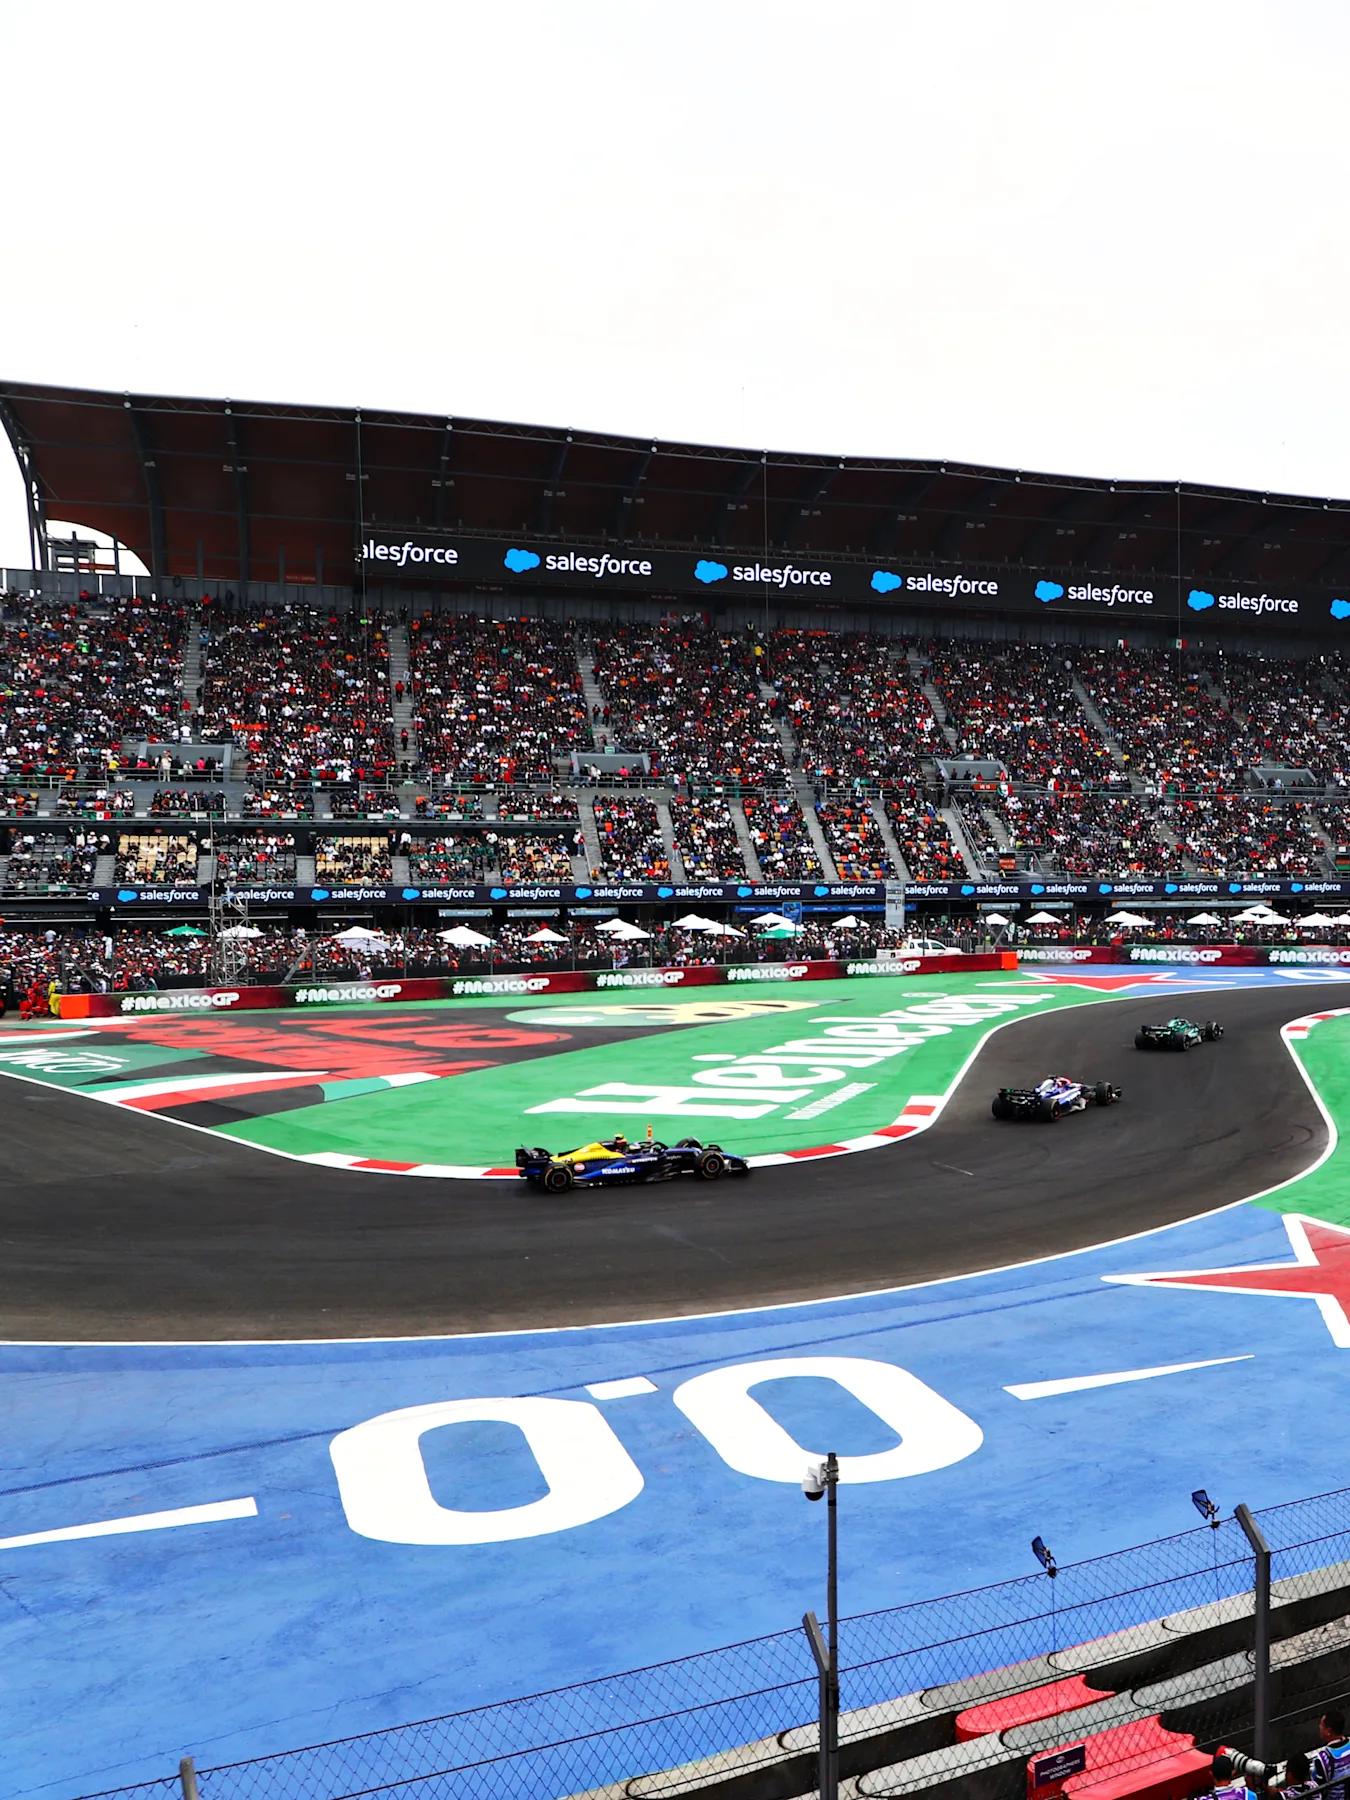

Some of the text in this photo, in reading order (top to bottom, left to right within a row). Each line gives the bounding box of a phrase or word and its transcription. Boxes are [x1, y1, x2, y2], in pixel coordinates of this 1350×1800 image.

[546, 552, 651, 577] salesforce
[733, 564, 831, 587] salesforce
[907, 574, 997, 597] salesforce
[1068, 583, 1153, 606] salesforce
[1219, 593, 1298, 614] salesforce
[510, 885, 560, 899] salesforce
[594, 885, 643, 899] salesforce
[676, 887, 723, 898] salesforce
[755, 884, 800, 897] salesforce
[830, 886, 876, 896] salesforce
[905, 883, 948, 898] salesforce
[975, 882, 1018, 895] salesforce
[1047, 882, 1089, 894] salesforce
[1114, 881, 1153, 894] salesforce
[1180, 883, 1217, 893] salesforce
[1243, 880, 1280, 893] salesforce
[1305, 883, 1340, 892] salesforce
[140, 890, 198, 902] salesforce
[332, 889, 386, 900] salesforce
[423, 888, 474, 900] salesforce
[1017, 949, 1091, 961] #MexicoGP
[1130, 948, 1221, 961] #MexicoGP
[727, 965, 807, 980] #MexicoGP
[847, 960, 920, 974] #MexicoGP
[596, 971, 683, 987] #MexicoGP
[453, 978, 549, 994] #MexicoGP
[296, 986, 401, 1003] #MexicoGP
[121, 993, 239, 1010] #MexicoGP
[602, 1166, 635, 1174] KOMATSU
[1040, 1759, 1080, 1776] PHOTOGRAPHERS
[1050, 1769, 1071, 1779] WINDOW
